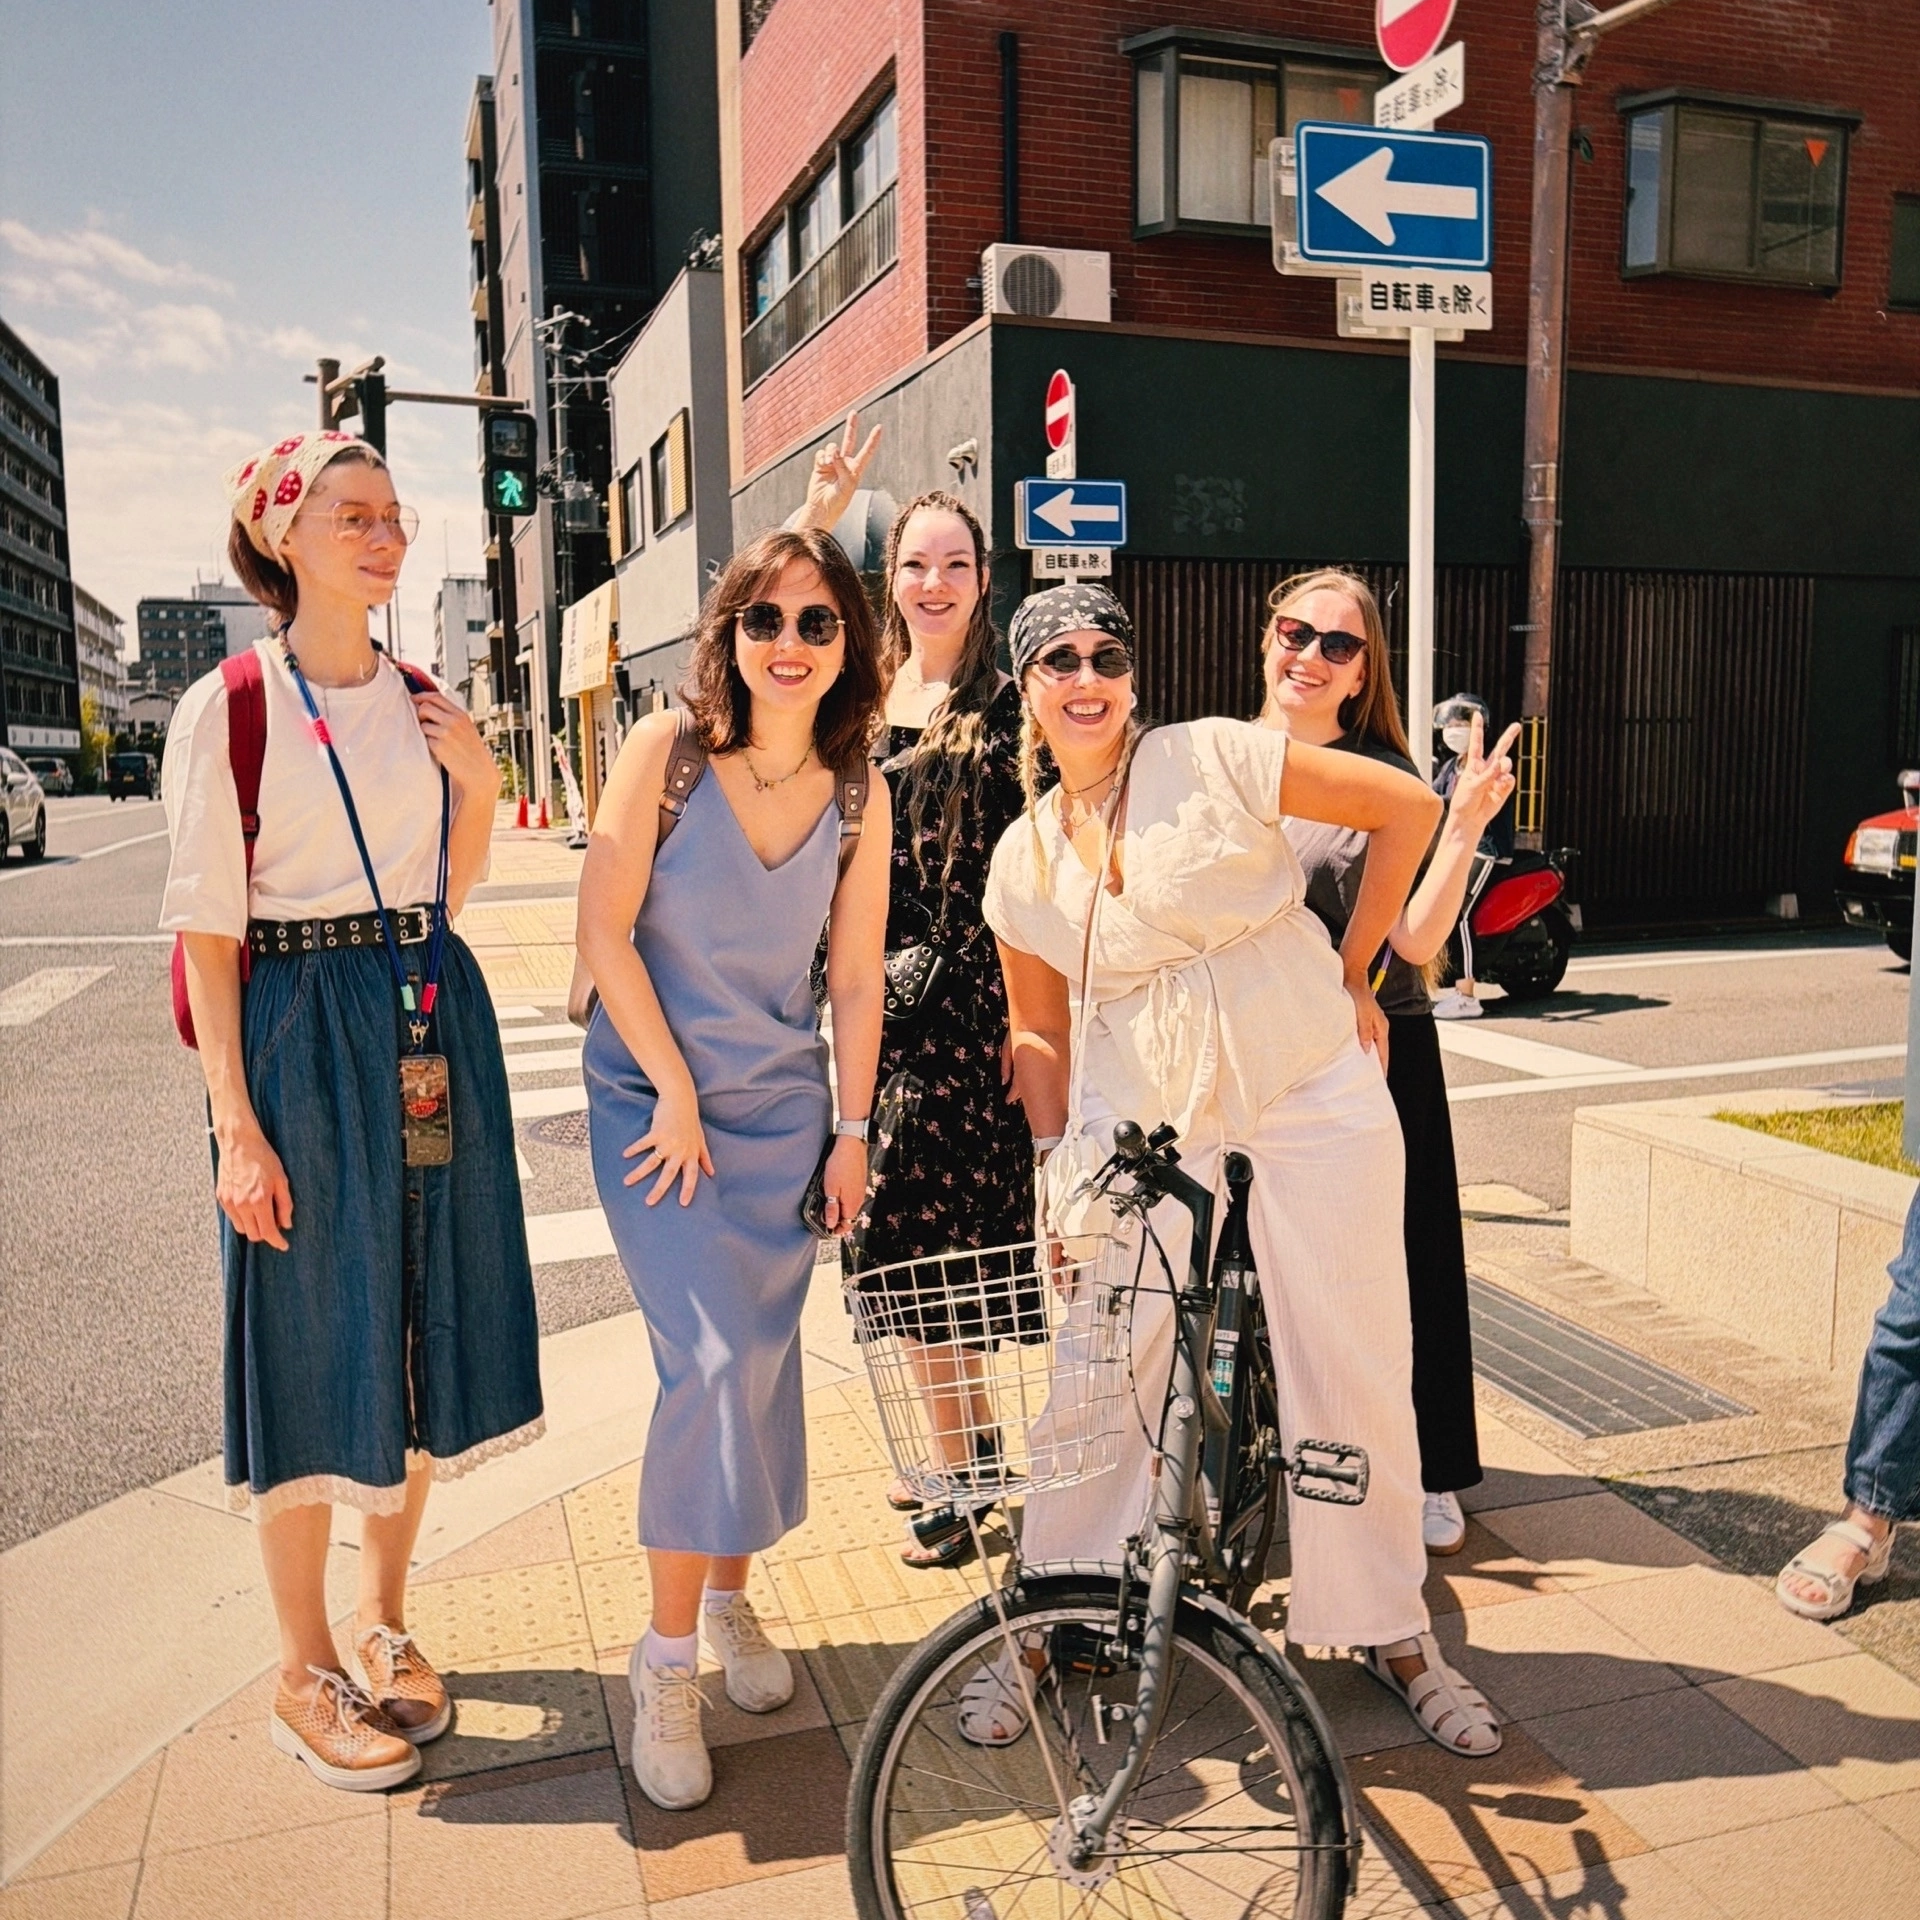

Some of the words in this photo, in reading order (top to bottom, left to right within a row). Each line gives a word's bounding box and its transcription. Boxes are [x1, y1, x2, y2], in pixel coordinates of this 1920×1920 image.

[1370, 281, 1487, 315] 自転車を除く
[1045, 553, 1107, 569] 自転車を除く
